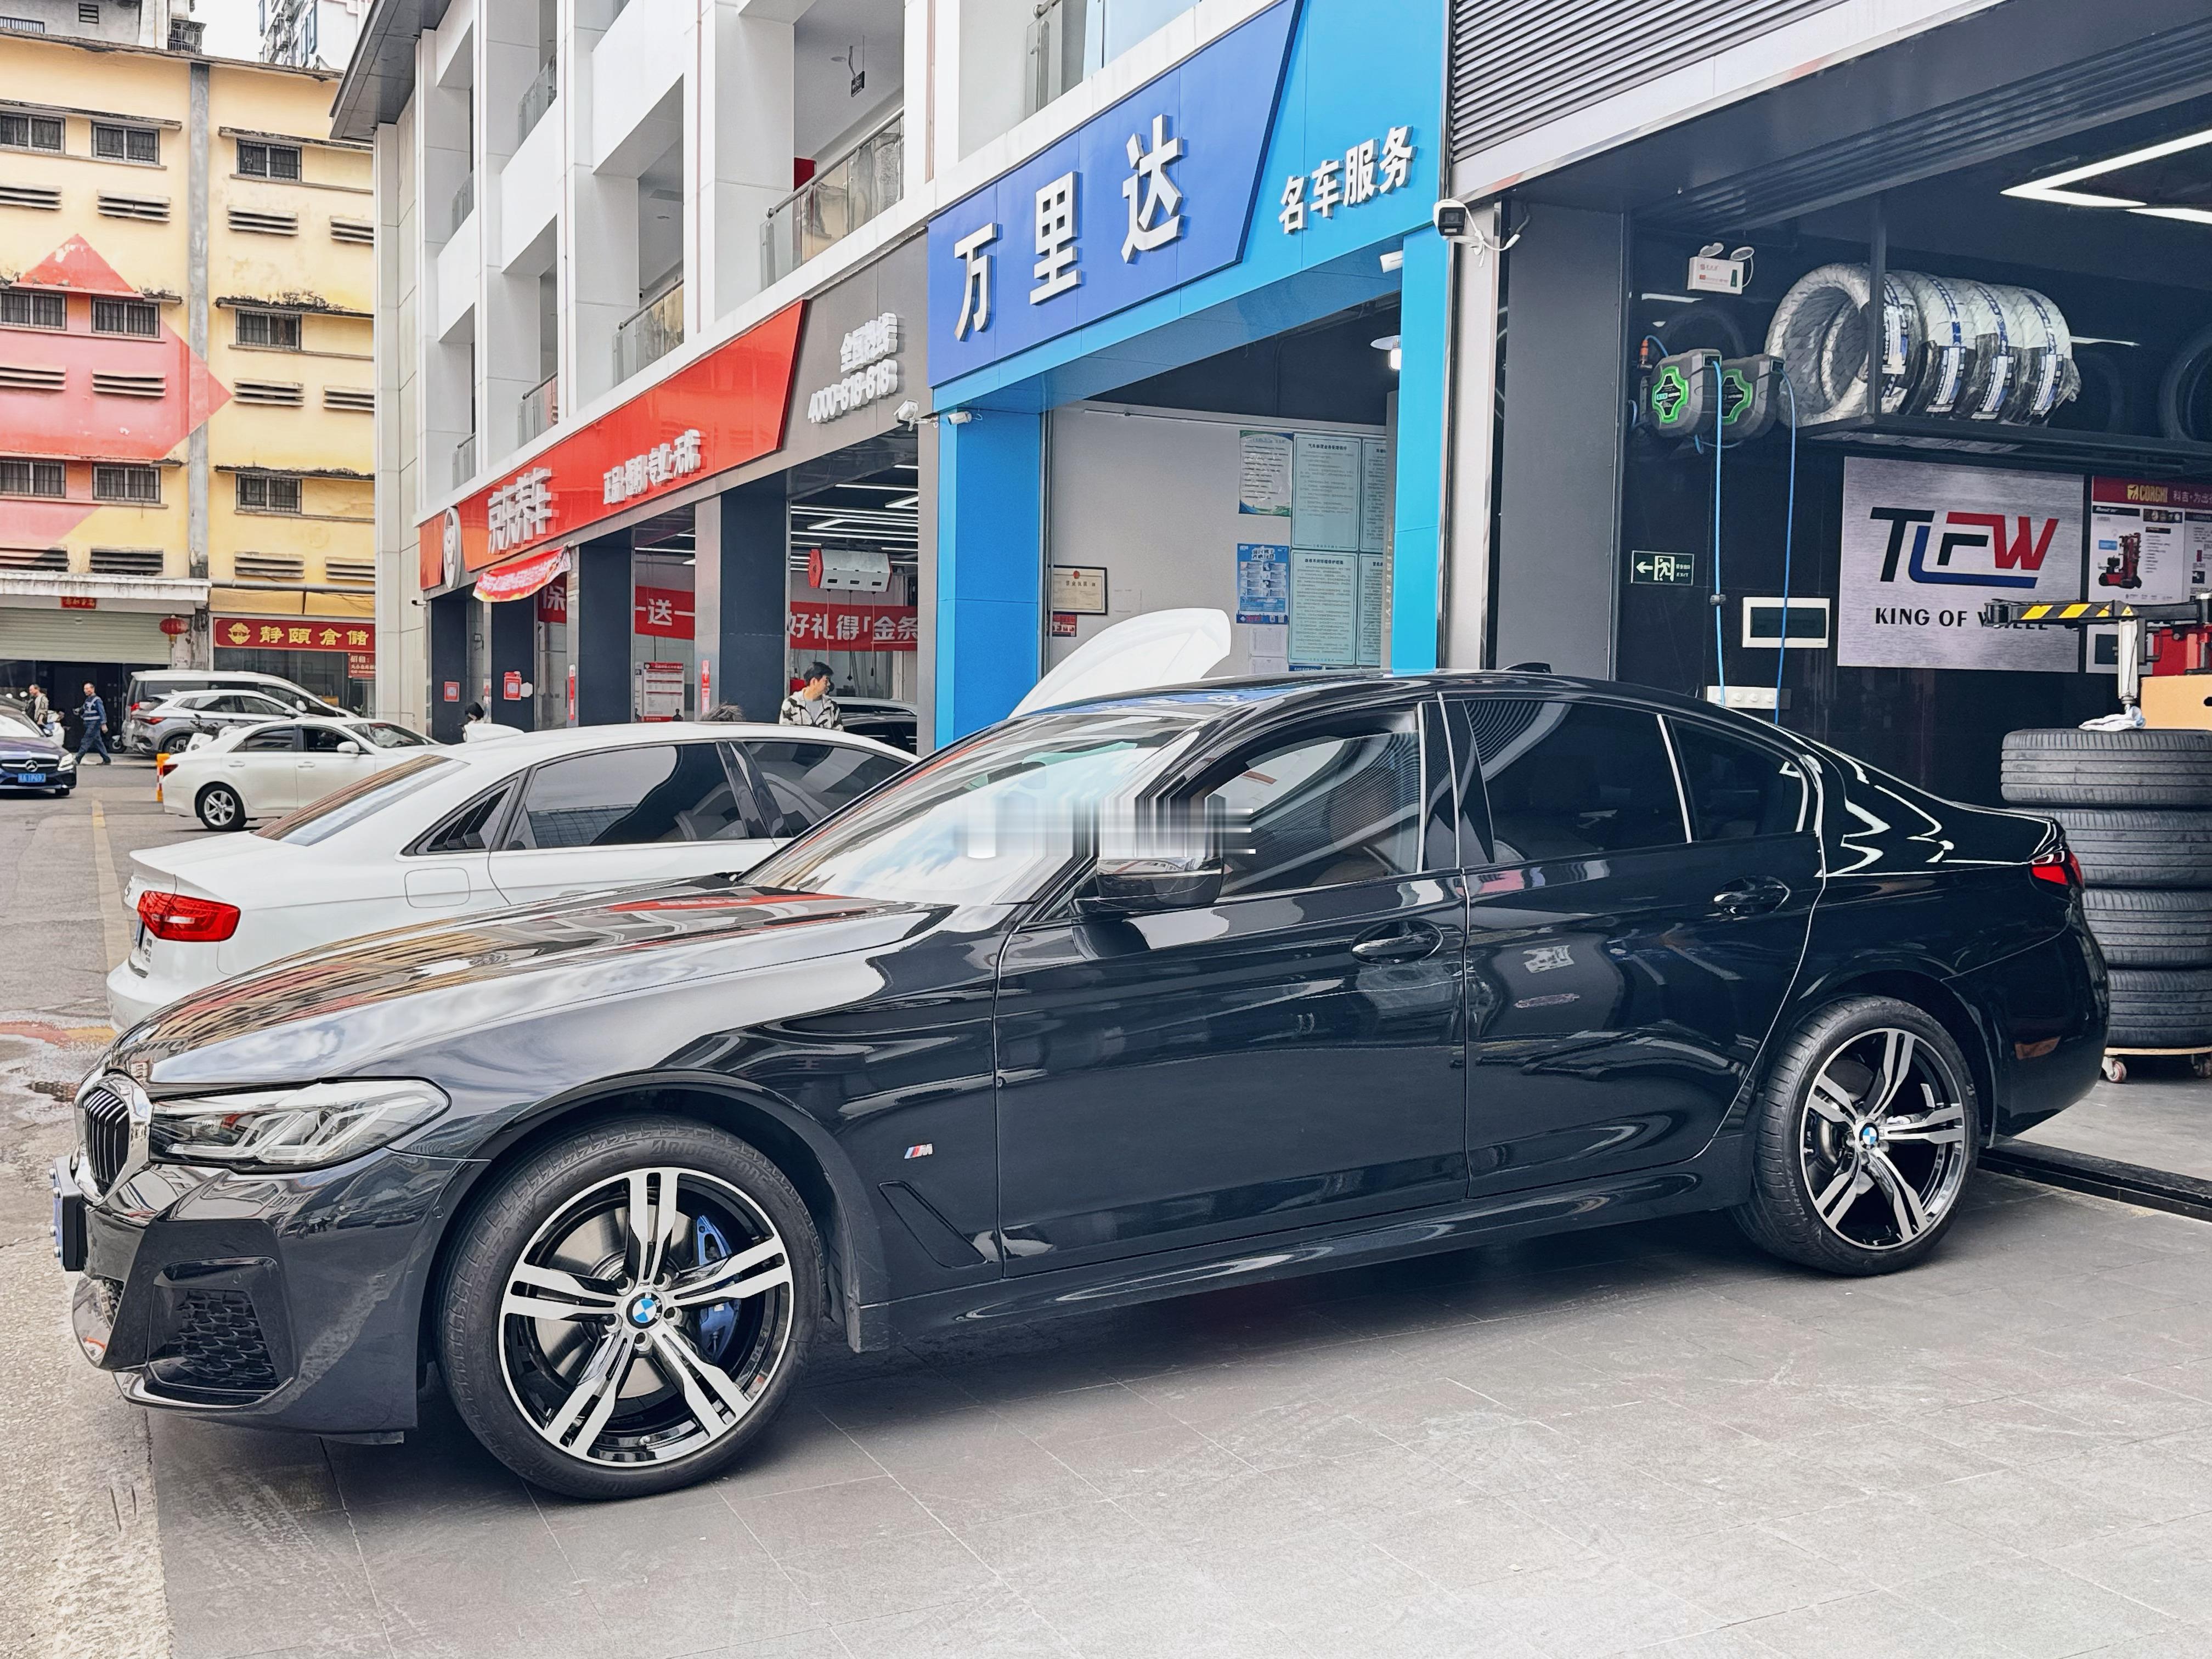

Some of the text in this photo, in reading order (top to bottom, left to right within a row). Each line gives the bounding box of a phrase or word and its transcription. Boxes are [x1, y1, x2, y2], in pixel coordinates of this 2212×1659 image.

[1279, 126, 1417, 234] 名车服务
[954, 114, 1188, 341] 万里达
[488, 467, 552, 554] 京东养车
[2140, 485, 2168, 503] CORGHI
[542, 585, 566, 611] 保
[1876, 607, 1930, 626] KING
[1939, 610, 1968, 627] OF
